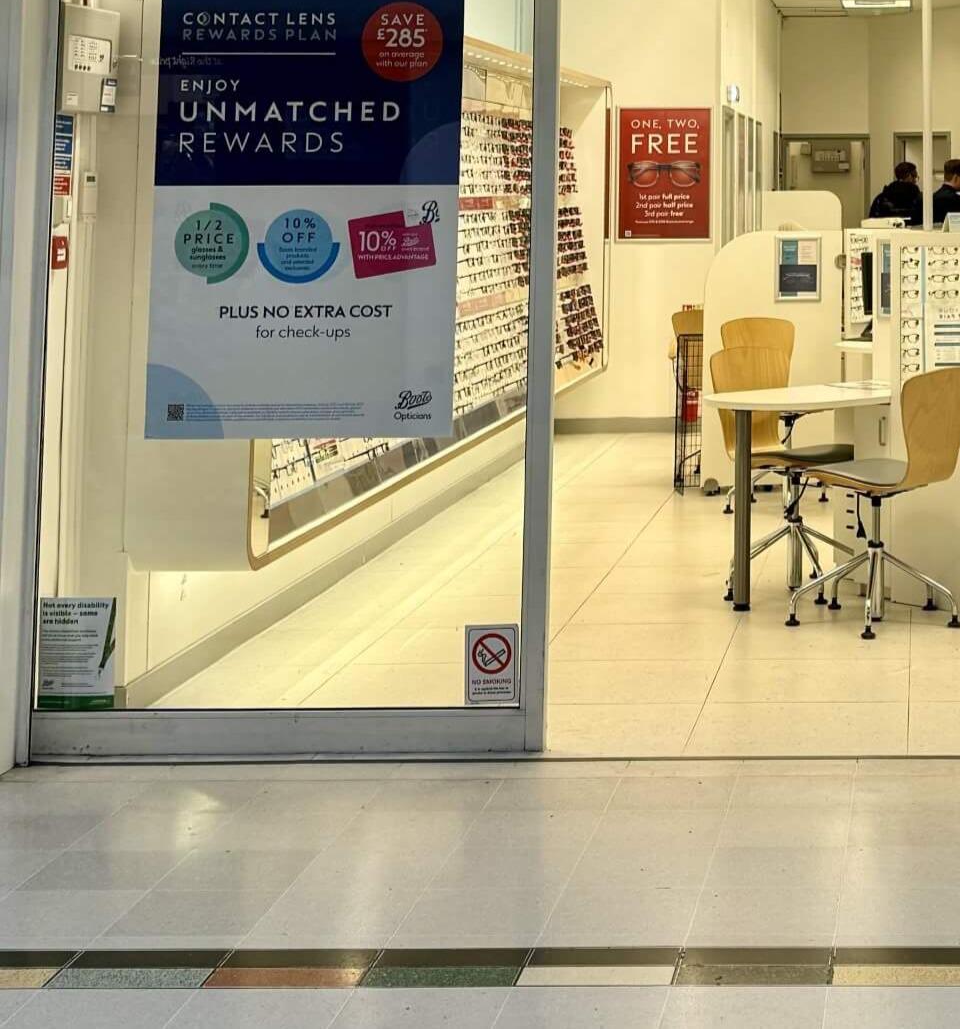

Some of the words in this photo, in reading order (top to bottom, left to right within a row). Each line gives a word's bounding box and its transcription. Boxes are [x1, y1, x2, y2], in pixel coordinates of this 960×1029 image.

[183, 12, 279, 26] CONTACT
[286, 12, 336, 26] LENS
[380, 14, 425, 26] SAVE
[182, 28, 278, 42] REWARDS
[285, 28, 337, 42] PLAN
[391, 51, 425, 60] average
[376, 59, 393, 67] with
[409, 59, 428, 69] plan
[180, 79, 240, 95] ENJOY
[179, 101, 401, 122] UNMATCHED
[630, 119, 662, 130] ONE,
[667, 119, 700, 130] TWO,
[179, 131, 344, 153] REWARDS
[631, 133, 699, 154] FREE
[673, 193, 690, 201] price
[662, 201, 676, 209] half
[676, 201, 694, 209] price
[196, 219, 222, 231] 1/2
[284, 217, 316, 229] 10%
[183, 233, 235, 245] PRICE
[281, 232, 316, 243] OFF
[358, 230, 397, 252] 10%
[218, 305, 259, 320] PLUS
[263, 305, 290, 319] NO
[294, 305, 346, 319] EXTRA
[349, 304, 393, 318] COST
[256, 325, 275, 338] for
[278, 325, 352, 340] check-ups
[393, 389, 433, 410] Boots
[393, 411, 432, 421] Opticians
